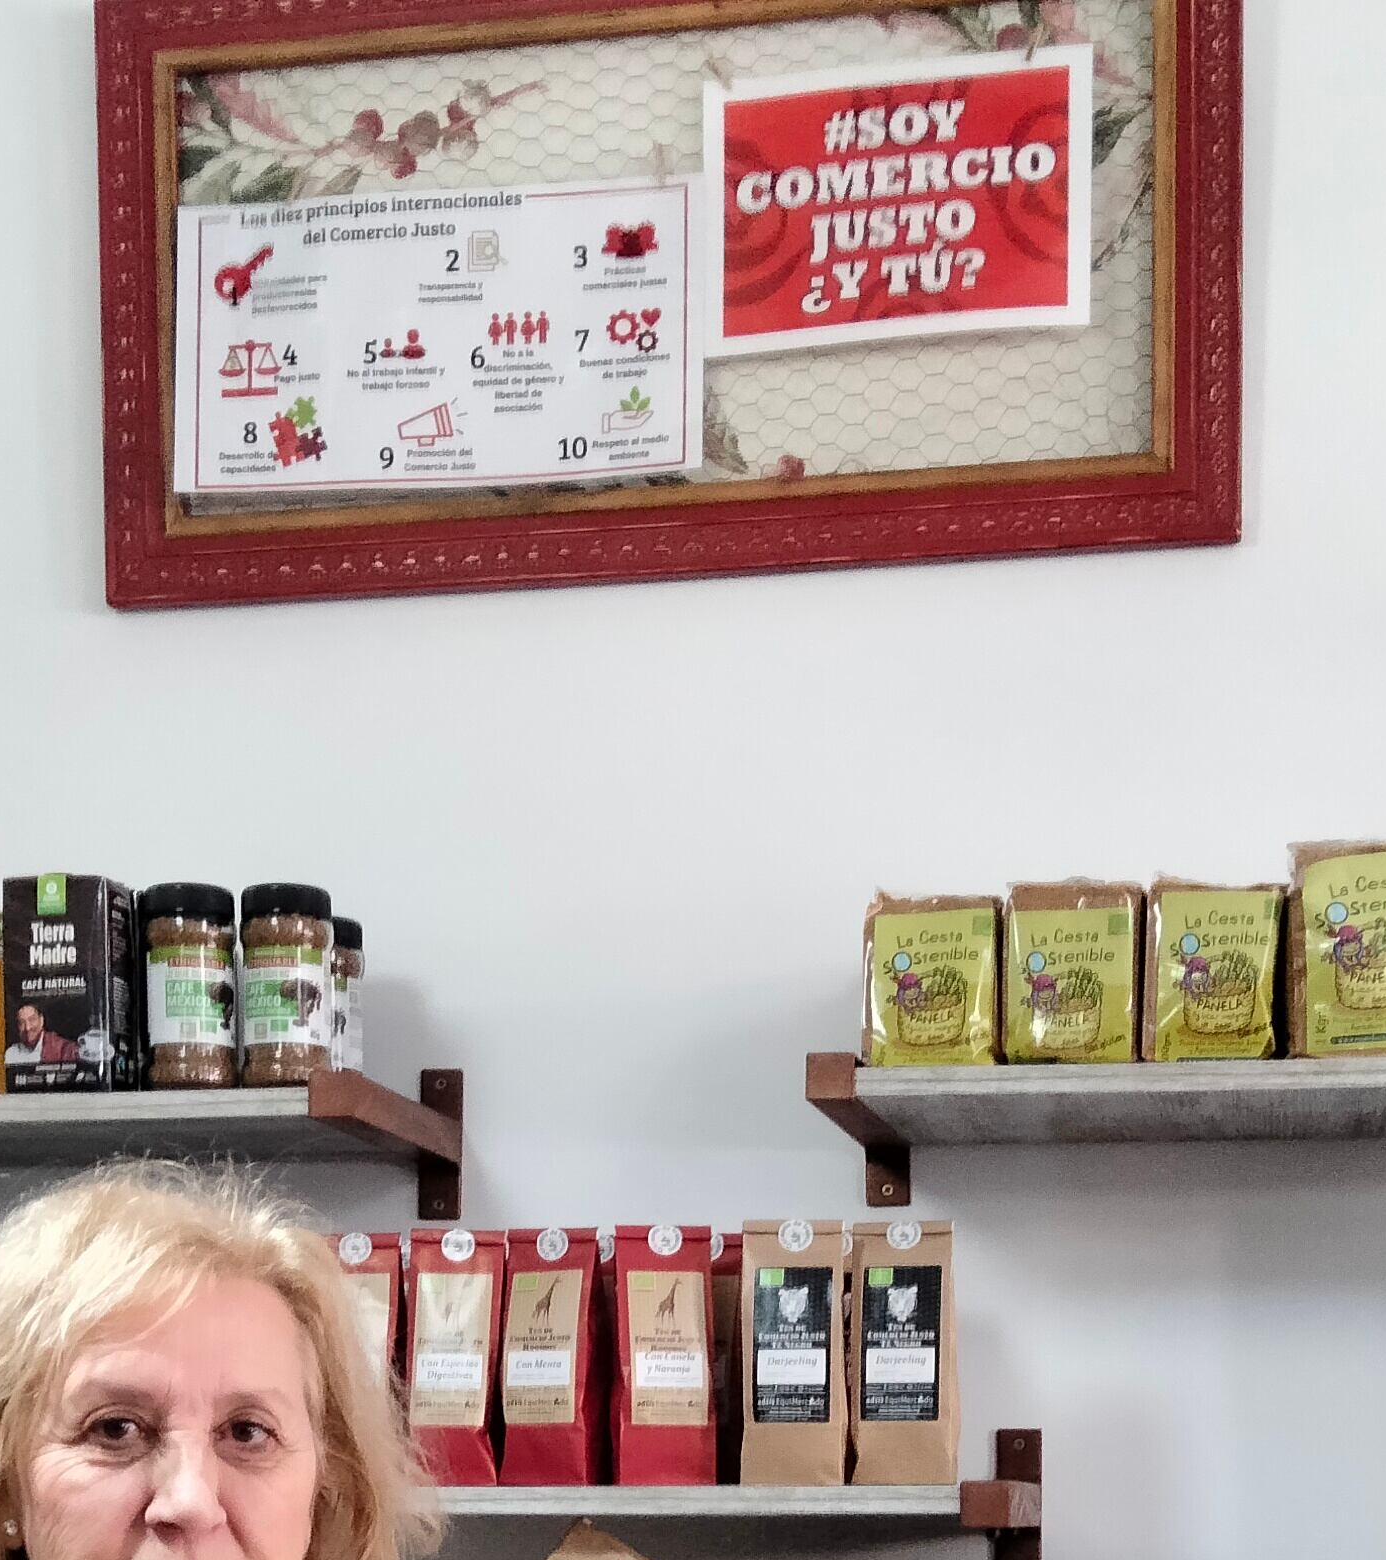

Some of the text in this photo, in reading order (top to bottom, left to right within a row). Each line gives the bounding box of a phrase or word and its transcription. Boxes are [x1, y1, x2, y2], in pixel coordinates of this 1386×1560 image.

[824, 99, 965, 154] #SOY
[736, 142, 1056, 214] COMERCIO
[270, 208, 303, 224] diez
[306, 199, 387, 225] principios
[391, 190, 522, 213] internacionales
[303, 221, 456, 245] del Comercio Justo
[810, 198, 975, 264] JUSTO
[445, 249, 460, 272] 2
[573, 245, 588, 268] 3
[801, 239, 985, 313] ¿Y TÚ?
[363, 339, 377, 364] 5
[574, 329, 590, 352] 7
[282, 344, 297, 366] 4
[470, 345, 485, 369] 6
[243, 421, 258, 443] 8
[379, 446, 394, 470] 9
[558, 436, 587, 461] 10
[1329, 881, 1351, 898] La
[30, 921, 75, 945] Tierra
[29, 945, 76, 967] Madre
